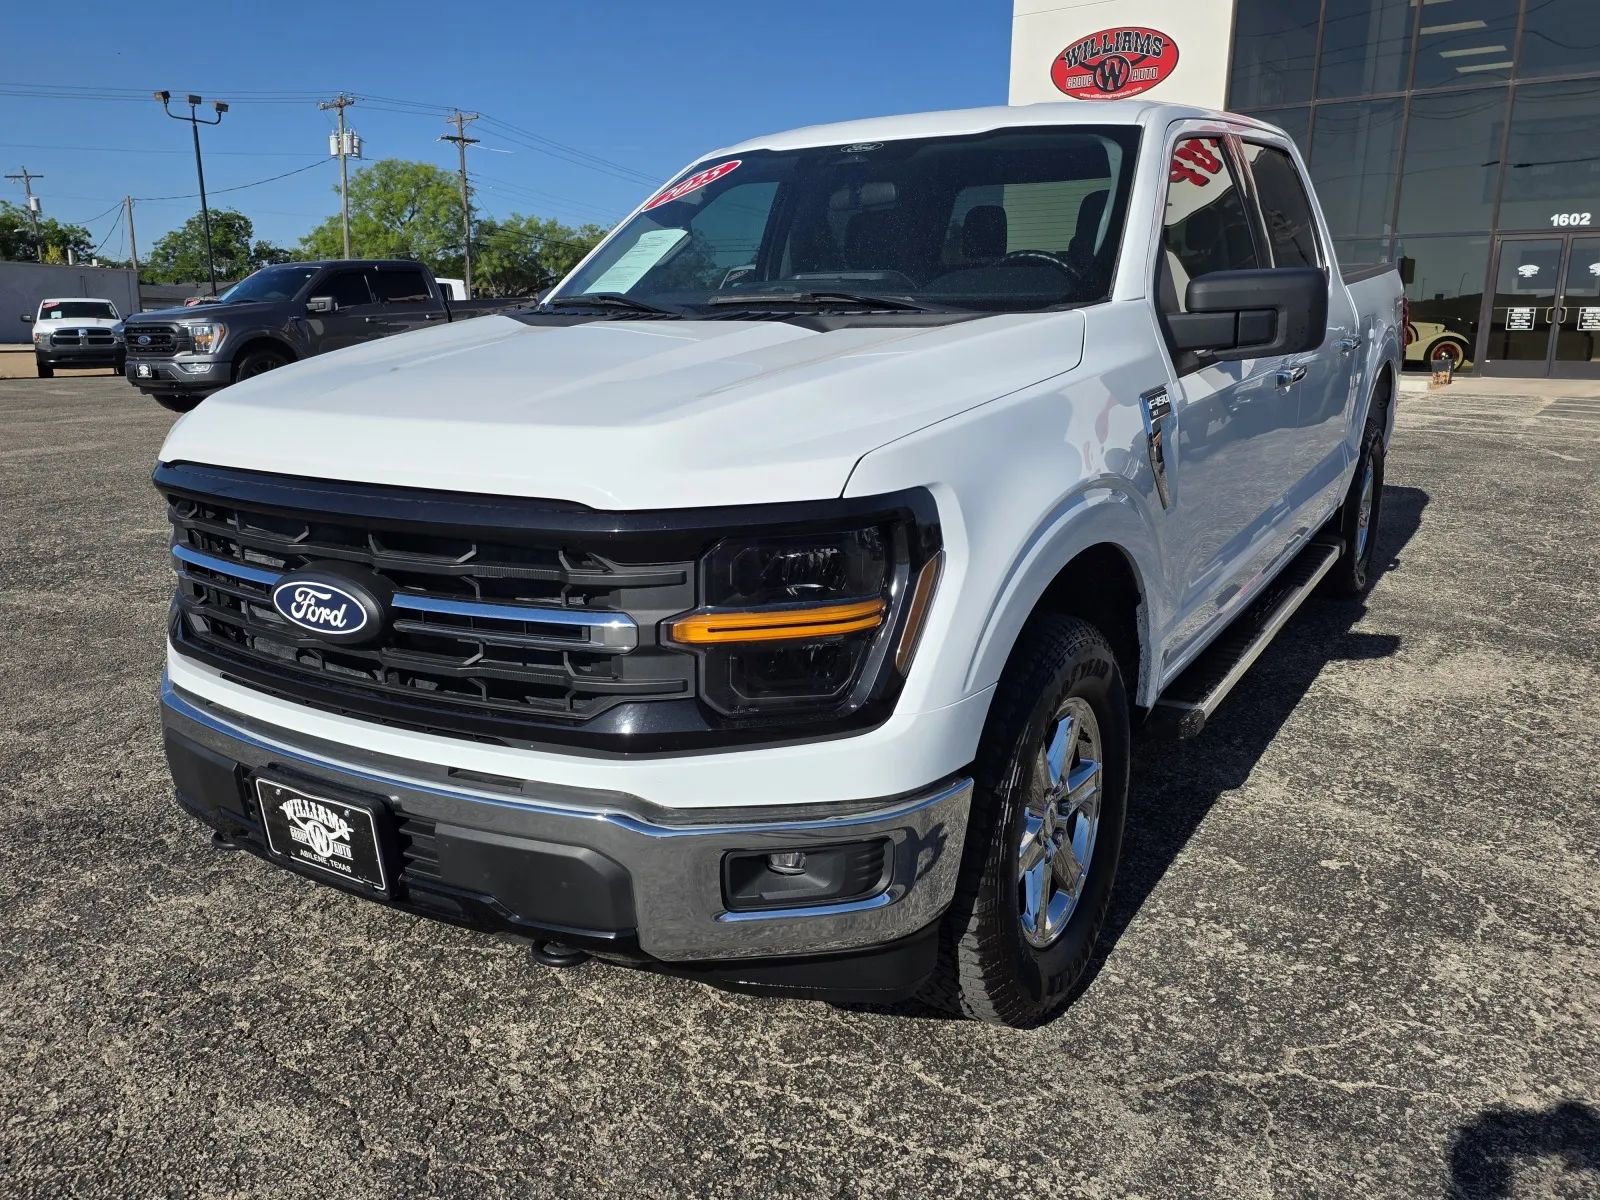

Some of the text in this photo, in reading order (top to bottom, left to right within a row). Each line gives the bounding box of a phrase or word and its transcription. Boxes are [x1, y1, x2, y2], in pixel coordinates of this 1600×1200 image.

[1064, 31, 1163, 69] WILLIAMS
[1066, 67, 1158, 88] GROUP AUTO
[1099, 57, 1123, 91] W
[1550, 212, 1591, 226] 1602
[291, 587, 347, 628] Ford
[282, 799, 349, 841] WILLIAMS
[300, 849, 352, 873] ABILENE, TEXAS
